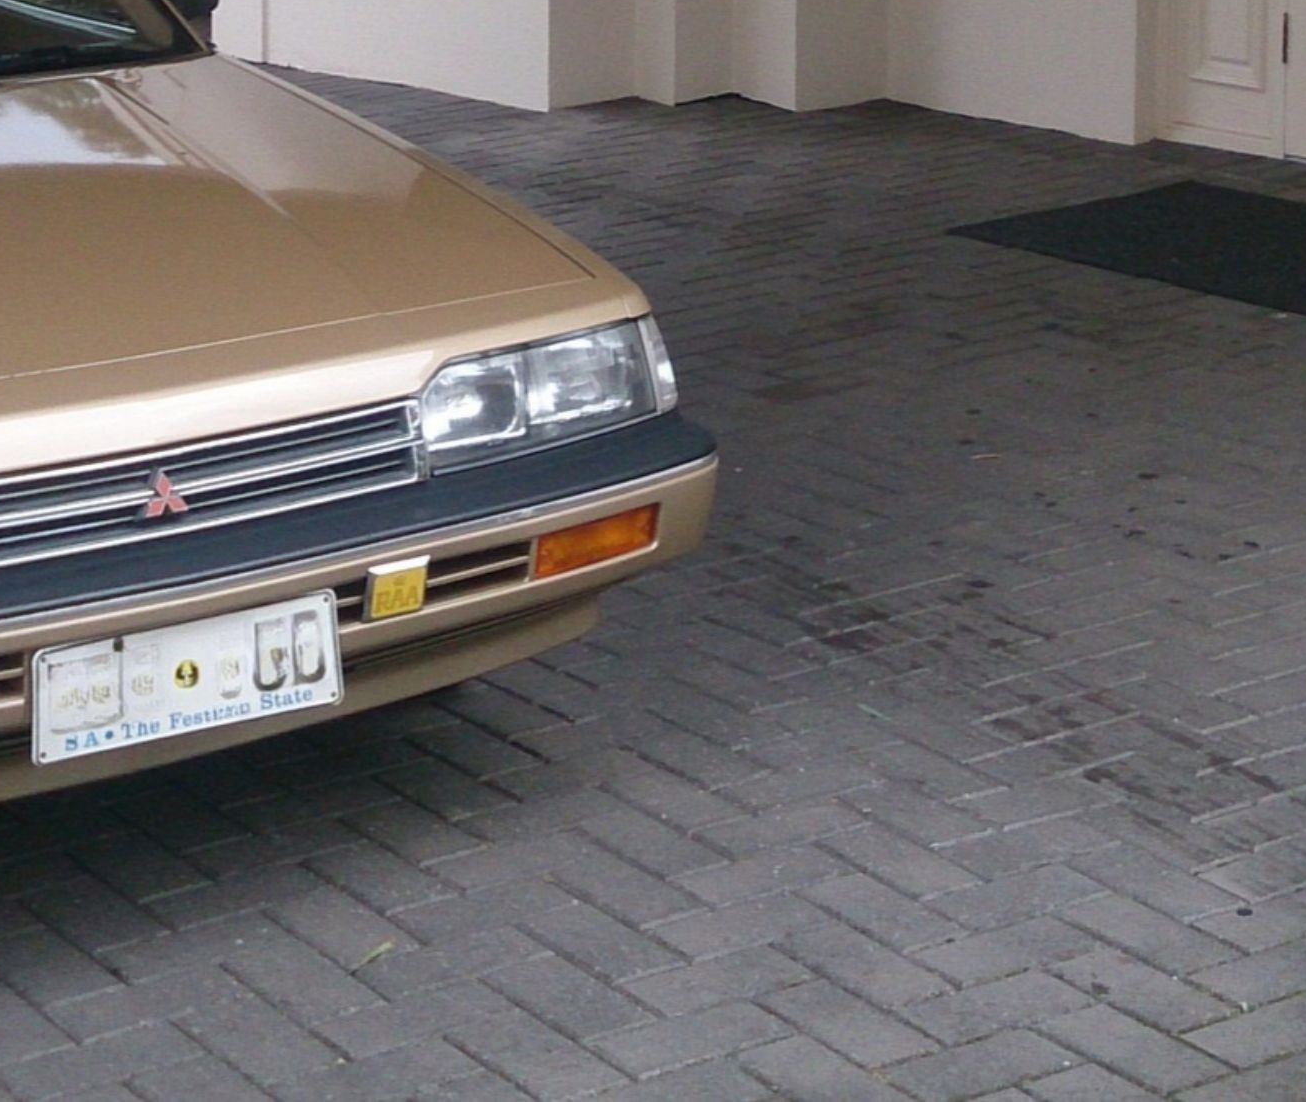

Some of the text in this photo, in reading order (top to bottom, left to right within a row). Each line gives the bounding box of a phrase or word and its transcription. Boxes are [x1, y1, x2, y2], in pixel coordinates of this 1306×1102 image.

[374, 585, 419, 615] RAA
[120, 721, 160, 739] The
[169, 701, 251, 729] Fest
[260, 688, 313, 710] State
